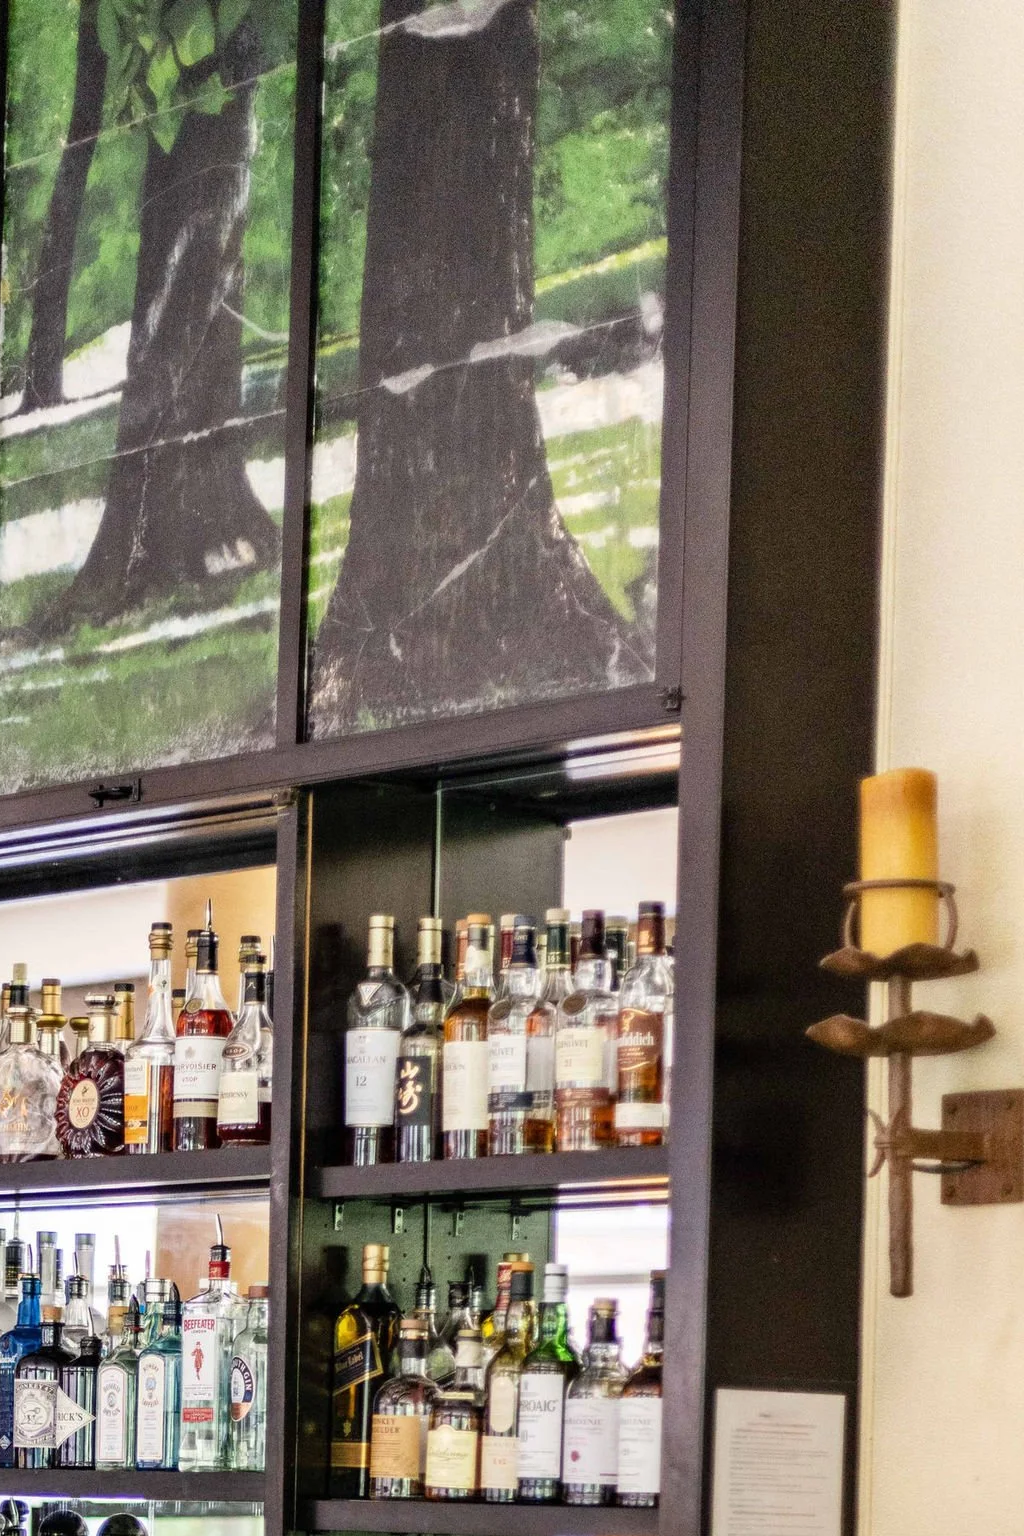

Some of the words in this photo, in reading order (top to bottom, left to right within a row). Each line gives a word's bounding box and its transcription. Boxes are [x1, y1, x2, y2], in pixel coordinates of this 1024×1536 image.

[355, 1076, 368, 1087] 12
[75, 1106, 90, 1118] XO
[183, 1319, 215, 1332] BEEFEATER
[243, 1372, 253, 1391] GIN
[520, 1399, 557, 1412] ROAIG
[57, 1412, 83, 1422] RICK'S
